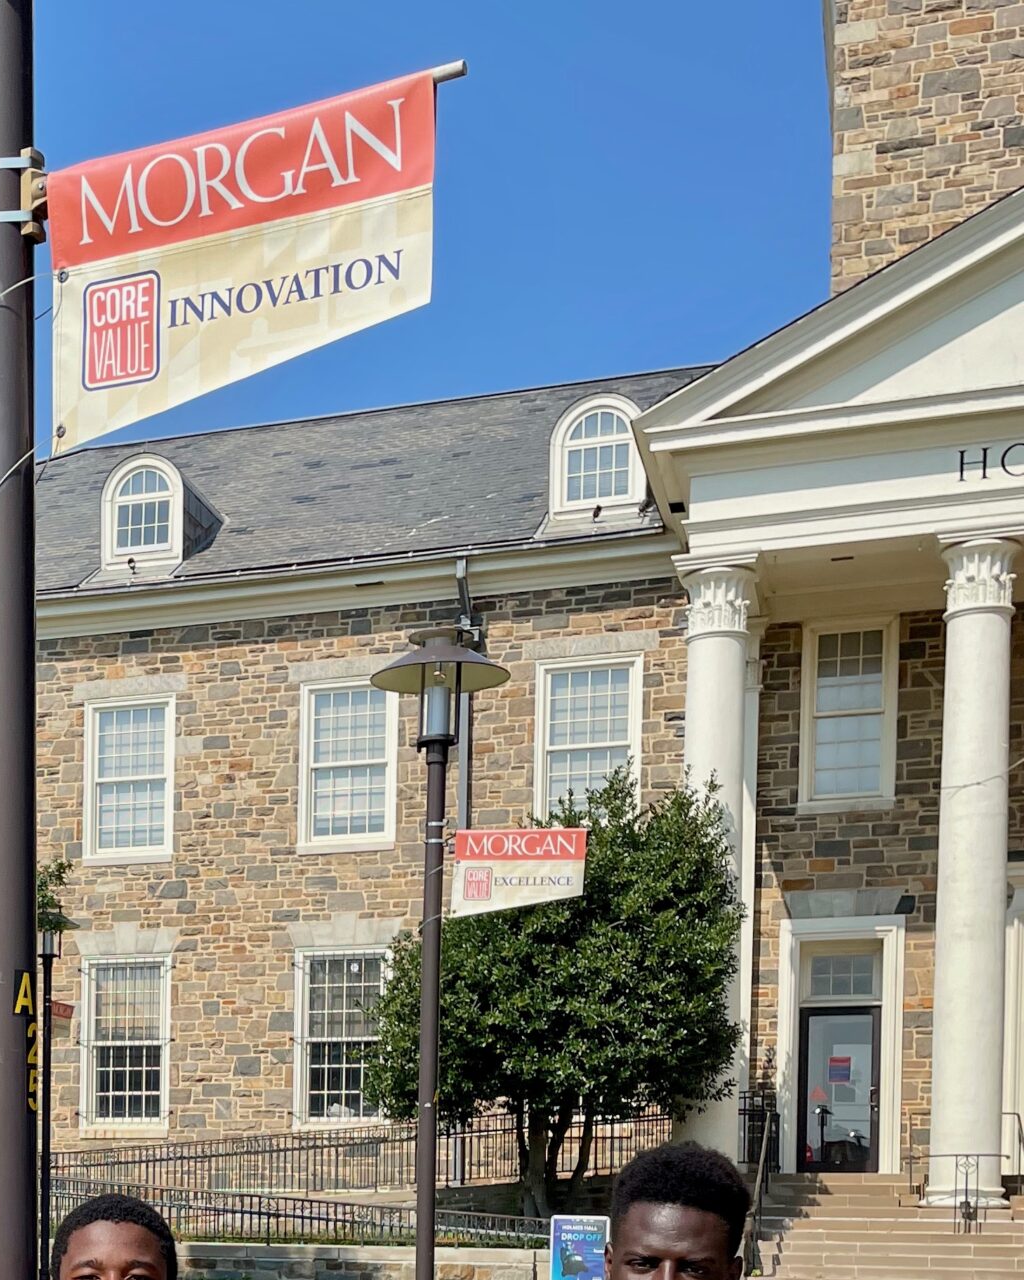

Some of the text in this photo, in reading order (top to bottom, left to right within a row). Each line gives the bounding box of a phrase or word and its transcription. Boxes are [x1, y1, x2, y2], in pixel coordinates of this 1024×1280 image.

[79, 97, 405, 245] MORGAN
[92, 282, 150, 325] CORE
[167, 249, 404, 328] INNOVATION
[93, 321, 150, 380] VALUE
[465, 834, 577, 856] MORGAN
[468, 869, 489, 882] CORE
[494, 876, 574, 887] EXCELLENCE
[561, 1232, 584, 1240] DROP
